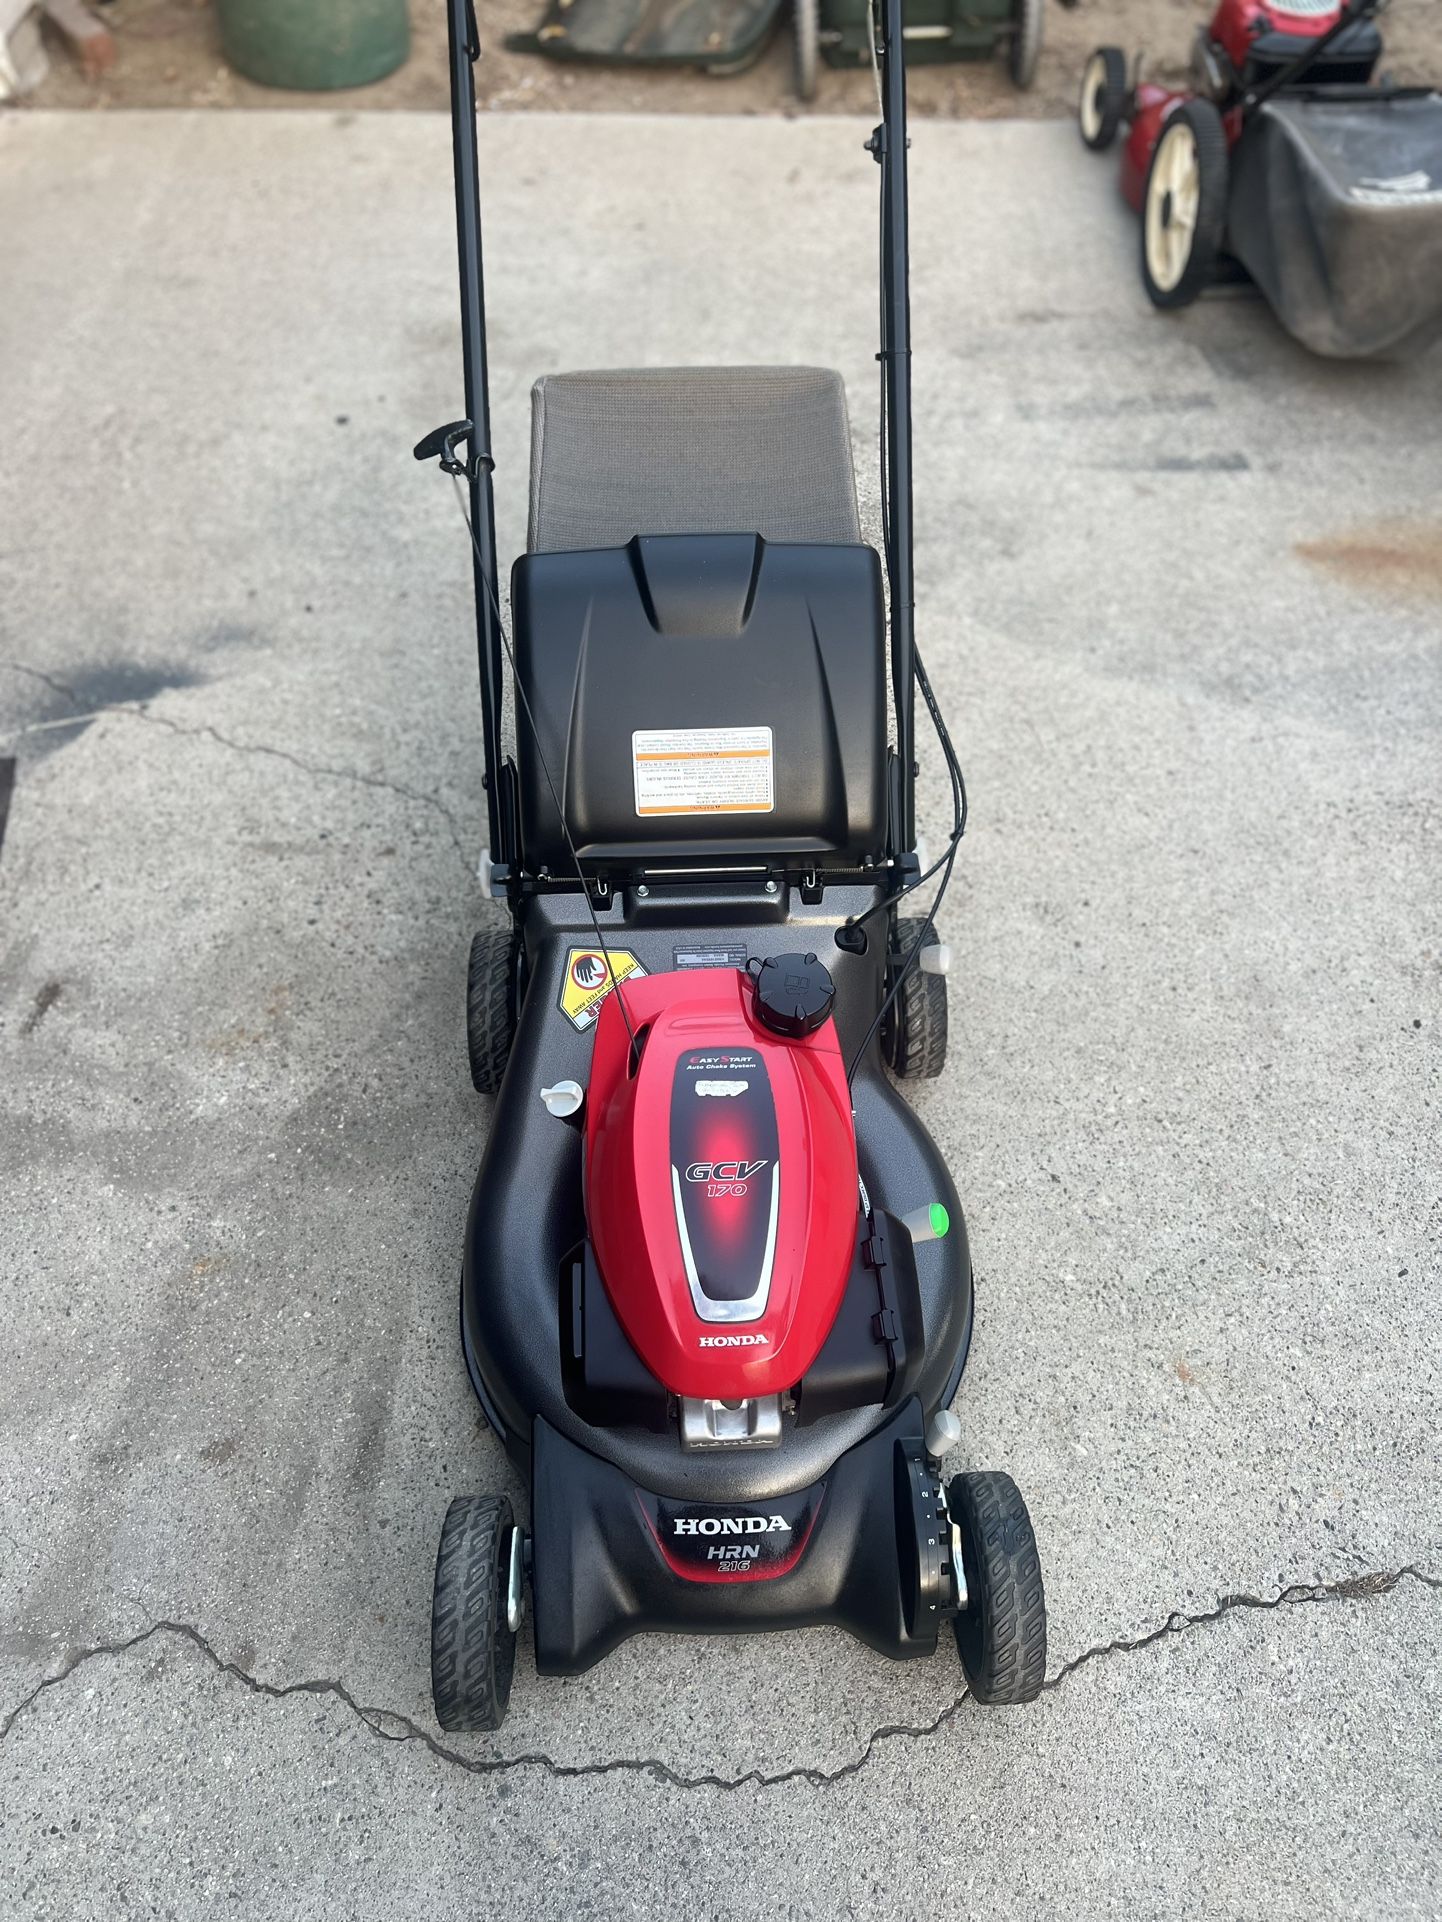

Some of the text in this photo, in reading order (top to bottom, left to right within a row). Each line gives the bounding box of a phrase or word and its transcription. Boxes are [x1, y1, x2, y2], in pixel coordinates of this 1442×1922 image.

[622, 963, 635, 975] KEEP
[605, 973, 623, 988] HADS
[585, 993, 598, 1004] FEET
[572, 1002, 586, 1014] AWAY
[689, 1055, 753, 1064] EASY START
[685, 1160, 769, 1182] GCV
[707, 1183, 748, 1197] 170
[699, 1334, 769, 1347] HONDA
[673, 1515, 792, 1536] HONDA
[707, 1544, 760, 1560] HRN
[717, 1560, 751, 1572] 216
